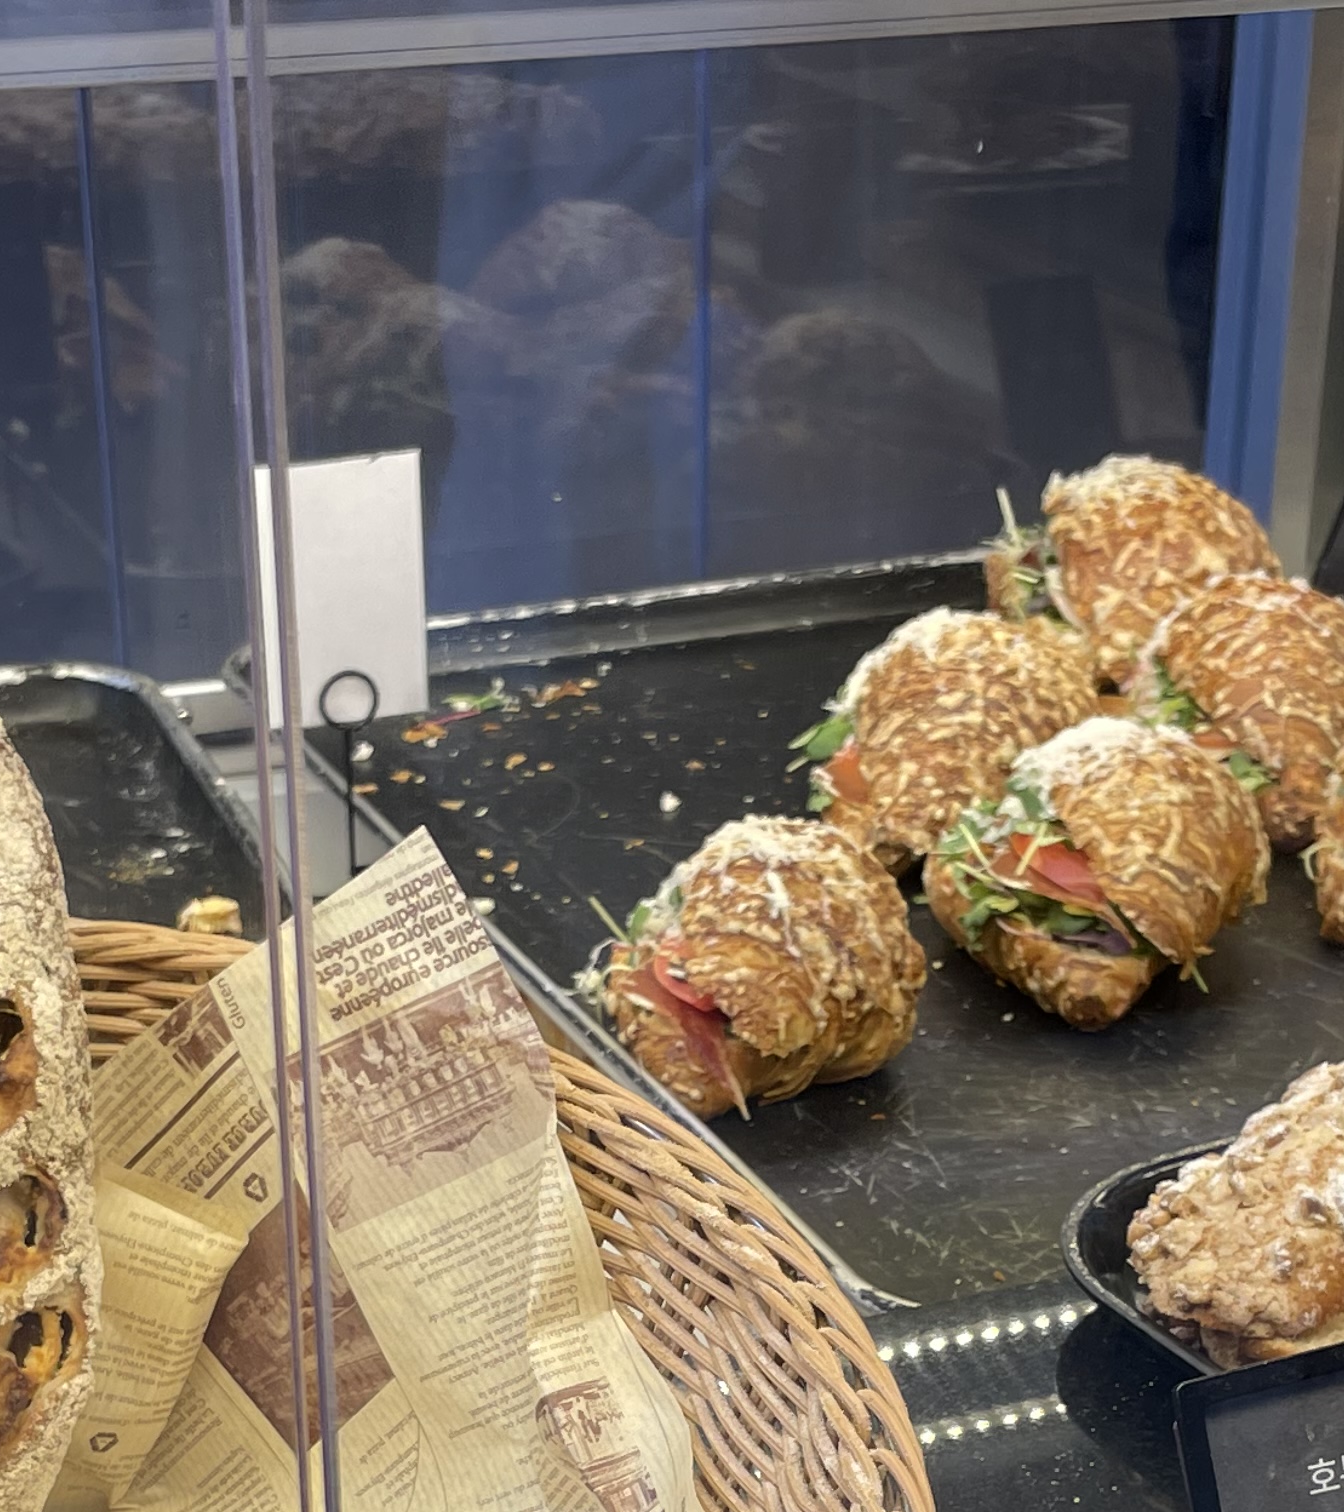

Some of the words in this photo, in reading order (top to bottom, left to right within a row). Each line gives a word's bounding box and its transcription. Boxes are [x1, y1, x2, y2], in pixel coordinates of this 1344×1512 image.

[387, 907, 453, 949] majorca
[316, 956, 359, 985] C'est
[356, 948, 420, 986] chaude
[360, 943, 384, 965] où
[216, 977, 246, 1030] Gluten
[330, 966, 429, 1021] européenne
[332, 979, 356, 999] et
